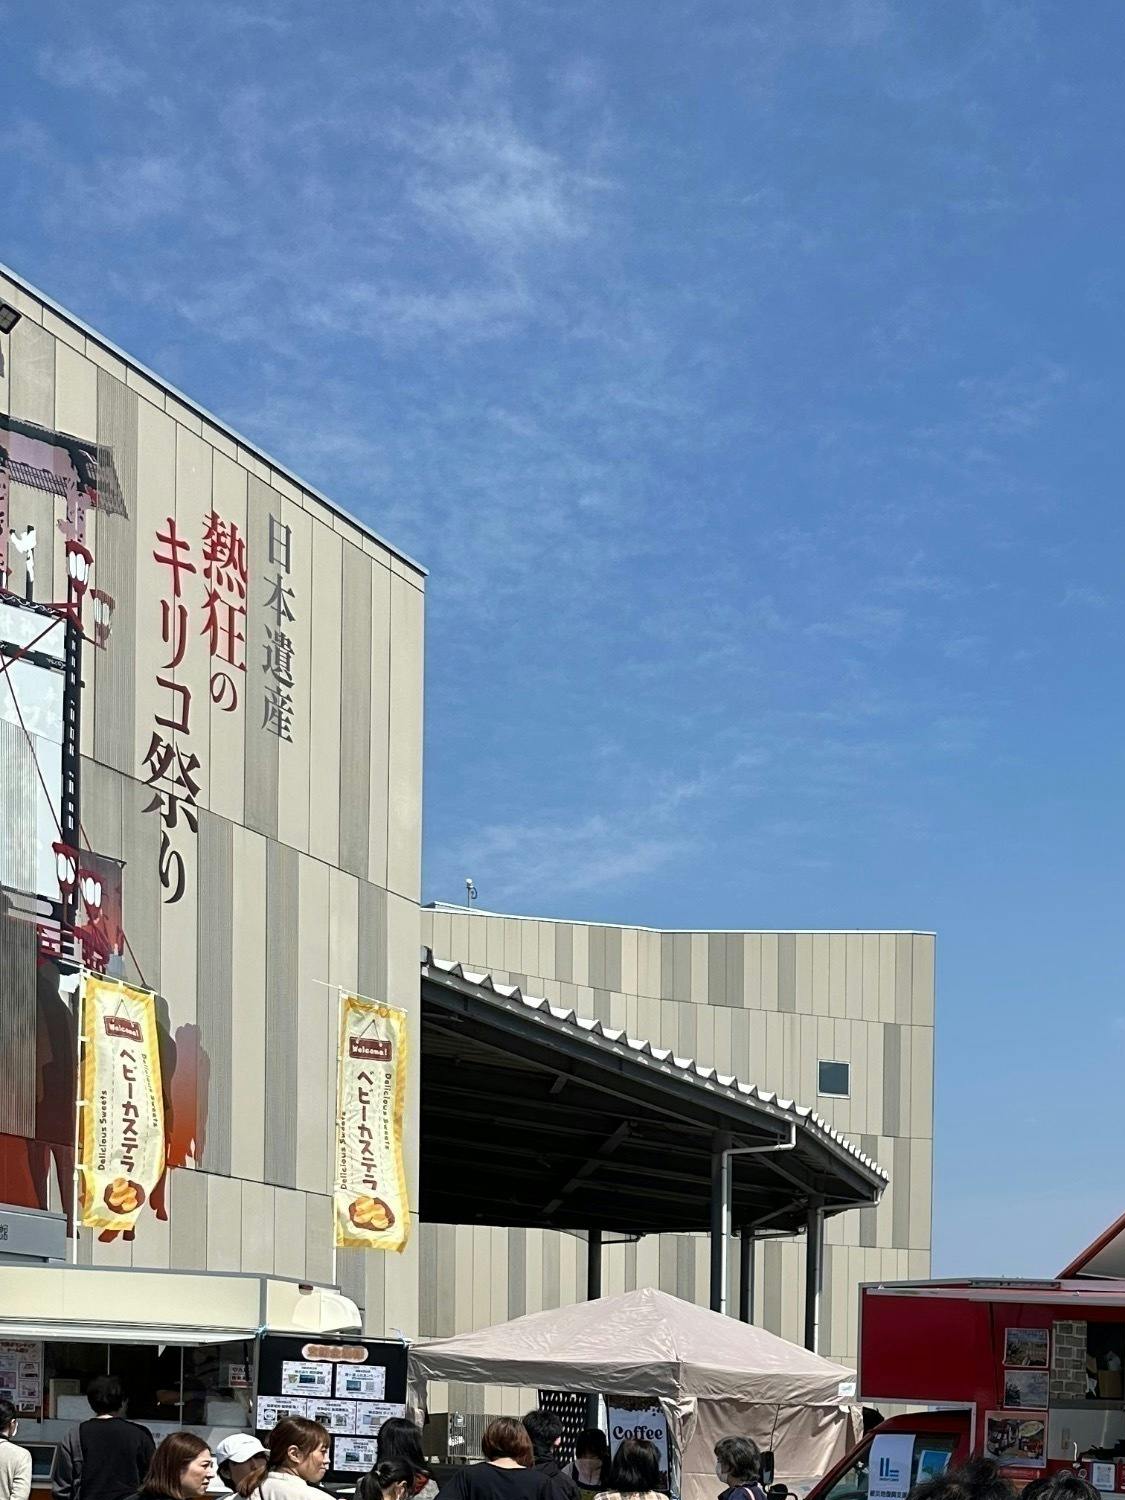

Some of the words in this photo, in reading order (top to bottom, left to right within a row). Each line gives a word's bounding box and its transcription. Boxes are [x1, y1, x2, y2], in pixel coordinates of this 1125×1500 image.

[201, 509, 249, 713] 熱狂の
[261, 512, 297, 744] 日本遺産
[140, 516, 202, 905] キリコ祭り
[97, 1127, 108, 1171] Delicious
[100, 1089, 108, 1124] Sweets
[613, 1426, 663, 1440] Coffee
